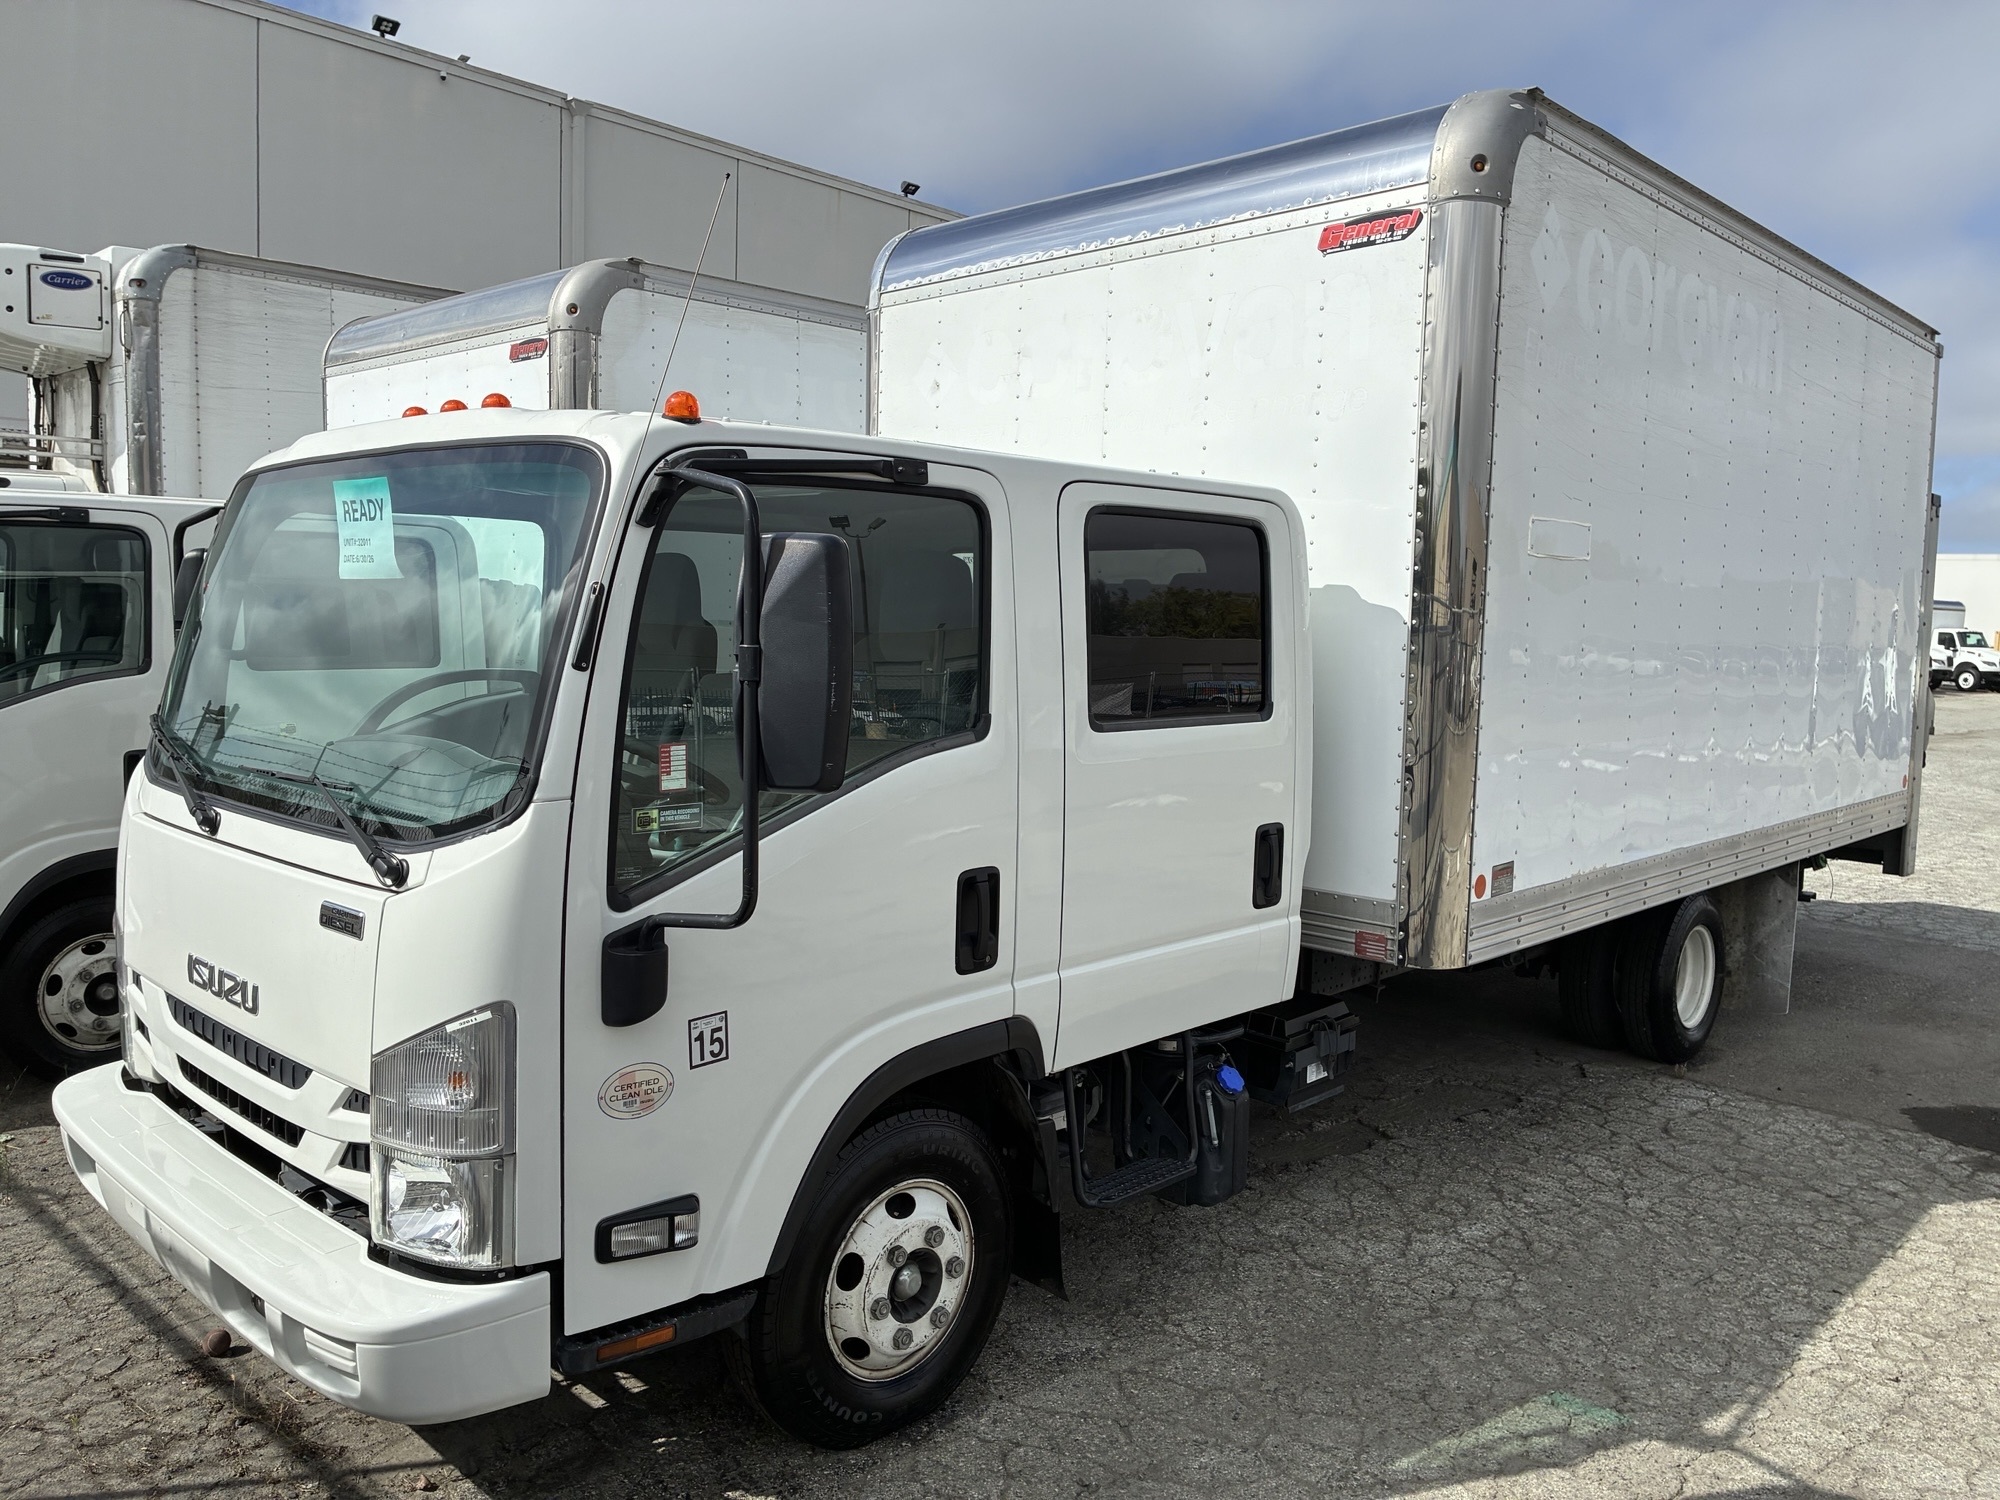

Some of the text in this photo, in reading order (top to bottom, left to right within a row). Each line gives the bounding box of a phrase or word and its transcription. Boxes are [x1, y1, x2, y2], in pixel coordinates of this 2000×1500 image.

[1318, 208, 1421, 251] General
[47, 274, 87, 286] Carrier
[342, 498, 383, 522] READY
[187, 952, 260, 1016] ISUZU
[694, 1026, 724, 1061] 15
[609, 1086, 664, 1102] CLEAN IDLE
[614, 1078, 660, 1092] CERTIFIED
